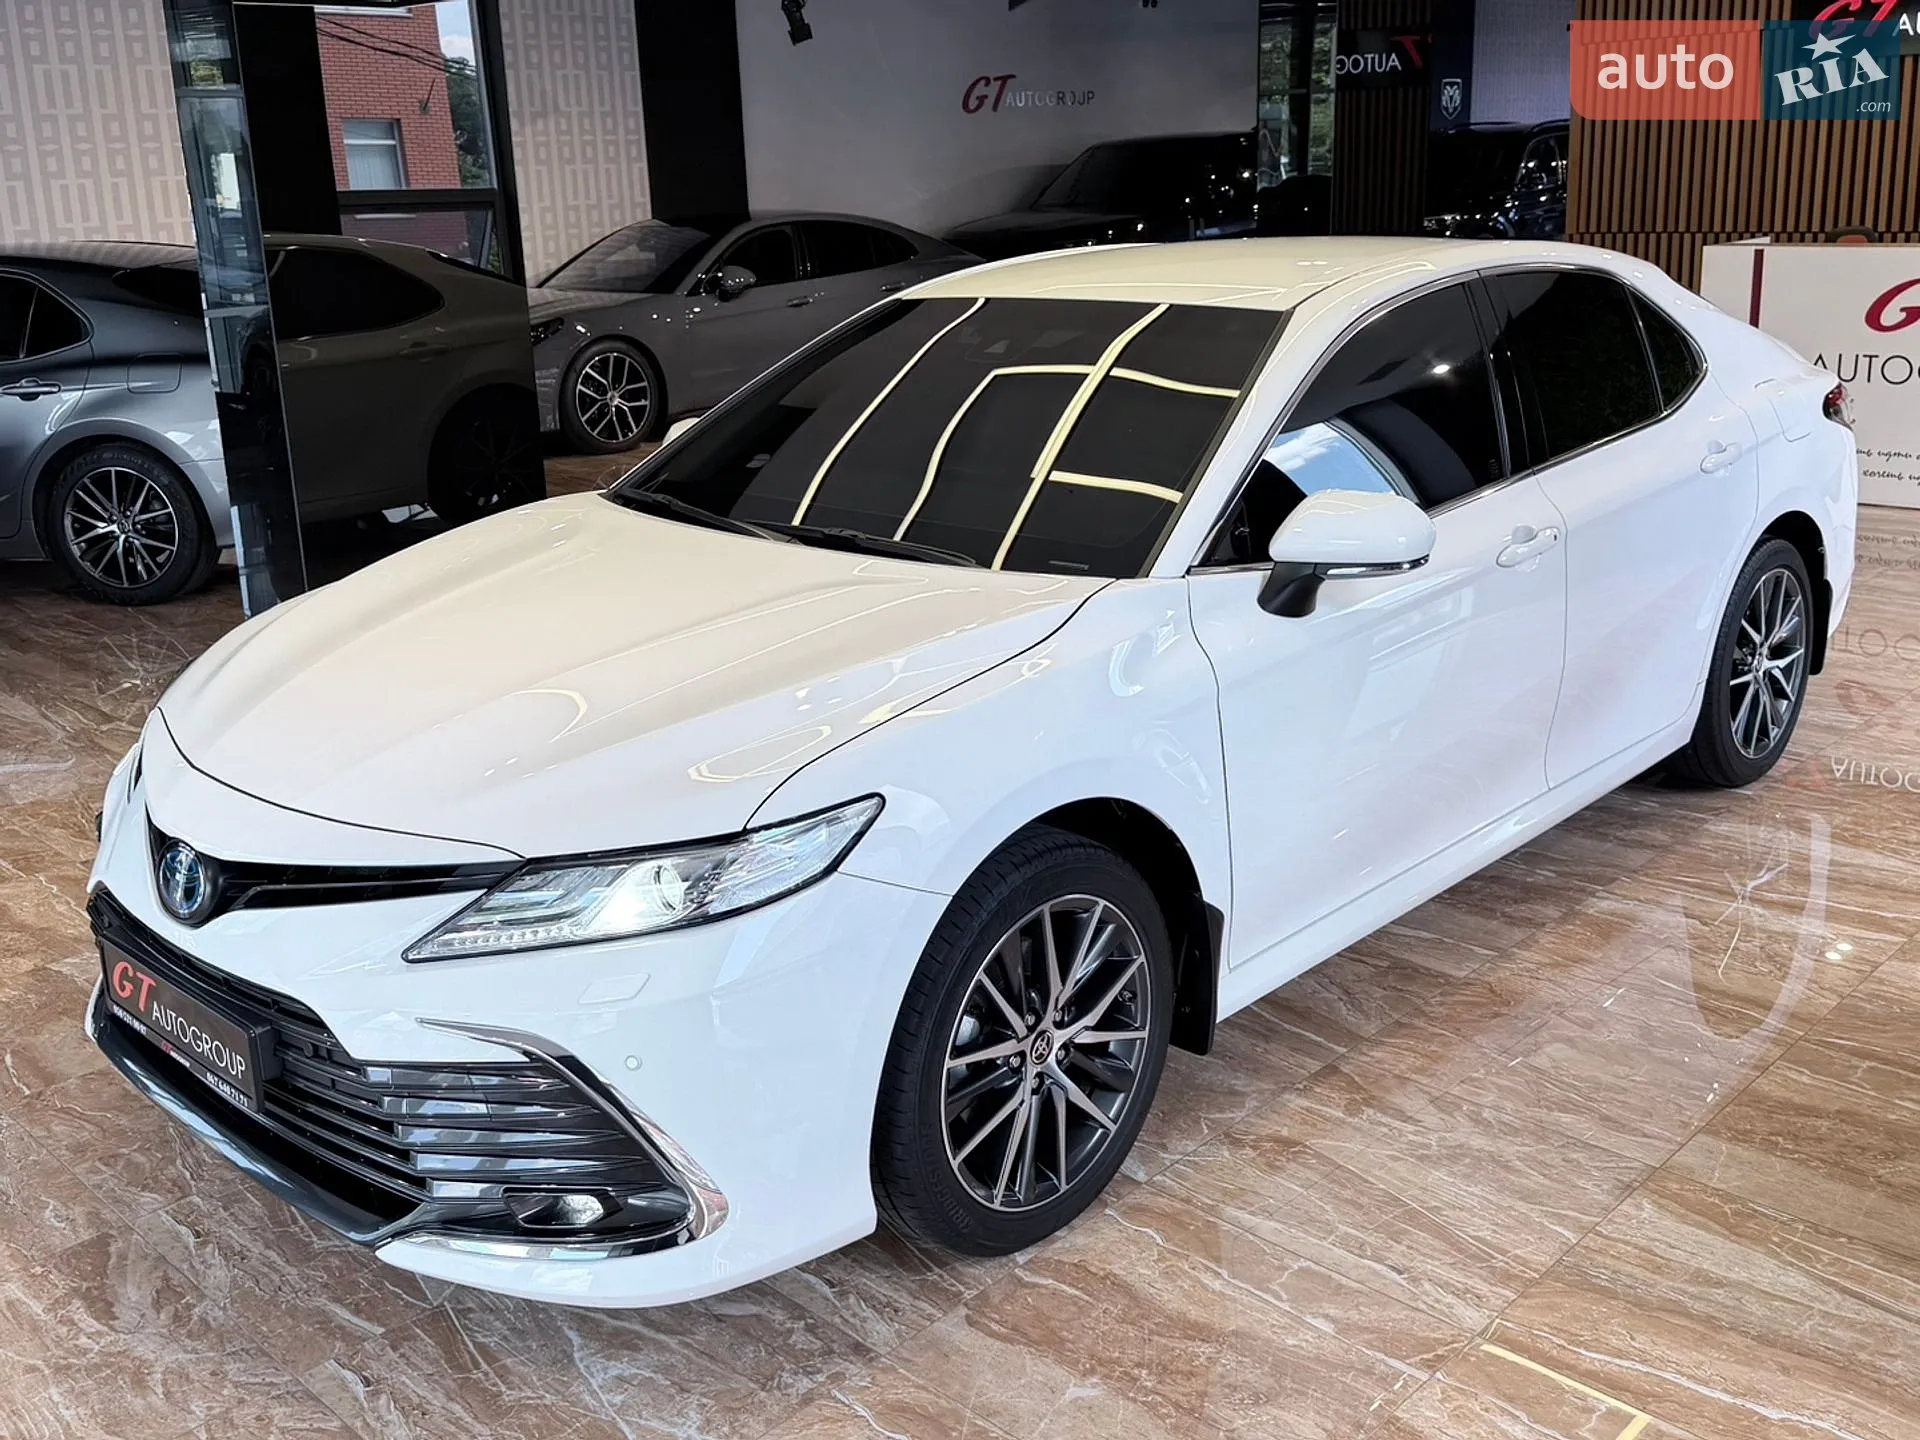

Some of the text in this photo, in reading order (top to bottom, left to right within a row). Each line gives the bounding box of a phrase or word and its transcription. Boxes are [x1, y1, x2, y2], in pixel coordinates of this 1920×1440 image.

[961, 74, 1096, 114] GT AUTOGROUP
[113, 961, 157, 1012] GT
[152, 1001, 246, 1079] AUTOGROUP
